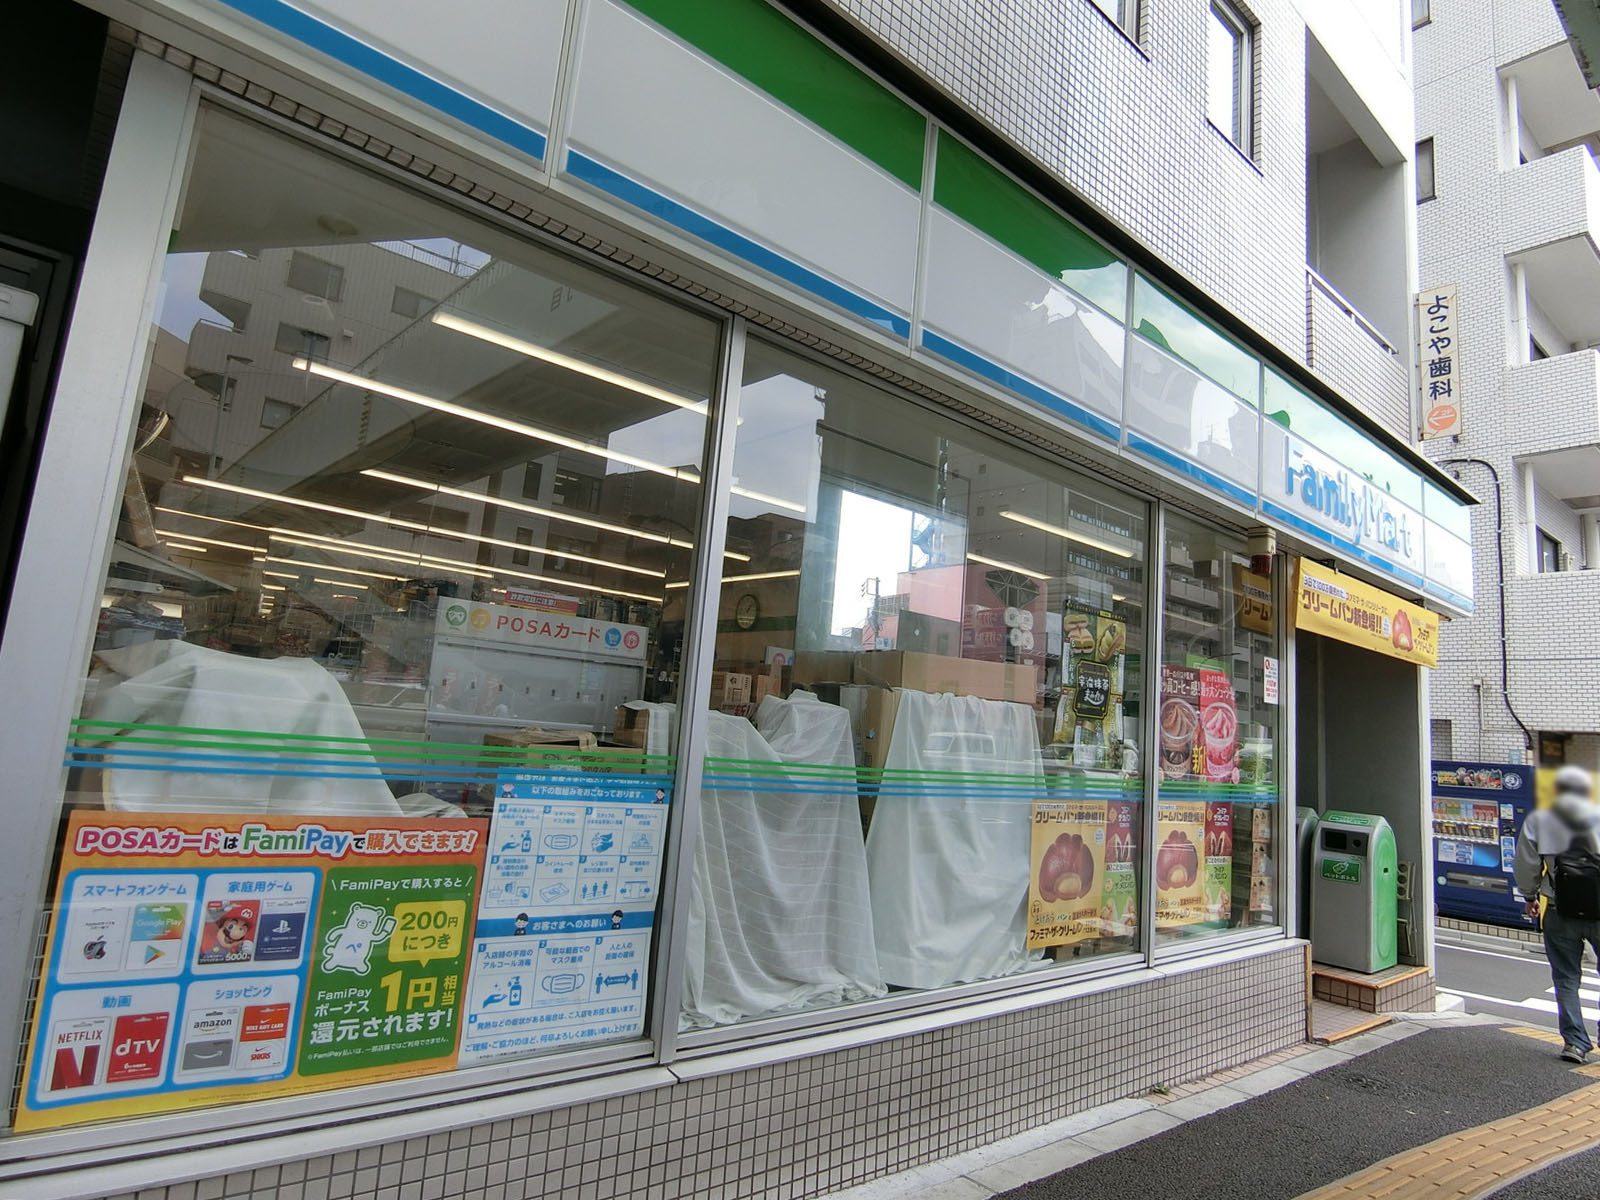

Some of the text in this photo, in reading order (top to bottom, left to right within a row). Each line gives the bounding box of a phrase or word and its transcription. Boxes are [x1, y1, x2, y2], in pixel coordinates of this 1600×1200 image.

[1427, 295, 1453, 400] よこや歯科
[496, 614, 601, 643] POSAカード
[83, 883, 187, 897] スマートフォンゲーム
[227, 880, 293, 894] 家庭用ゲーム
[399, 910, 458, 931] 200円
[532, 919, 606, 931] お客さまへのお願い
[402, 933, 451, 951] につき
[215, 985, 273, 999] ショッピング
[317, 988, 372, 1001] FamiPay
[441, 975, 458, 1006] 相当
[101, 995, 133, 1009] 動画
[314, 1000, 370, 1017] ボーナス
[193, 1018, 232, 1029] amazon
[57, 1030, 104, 1044] NETFLIX
[115, 1038, 161, 1056] dTV
